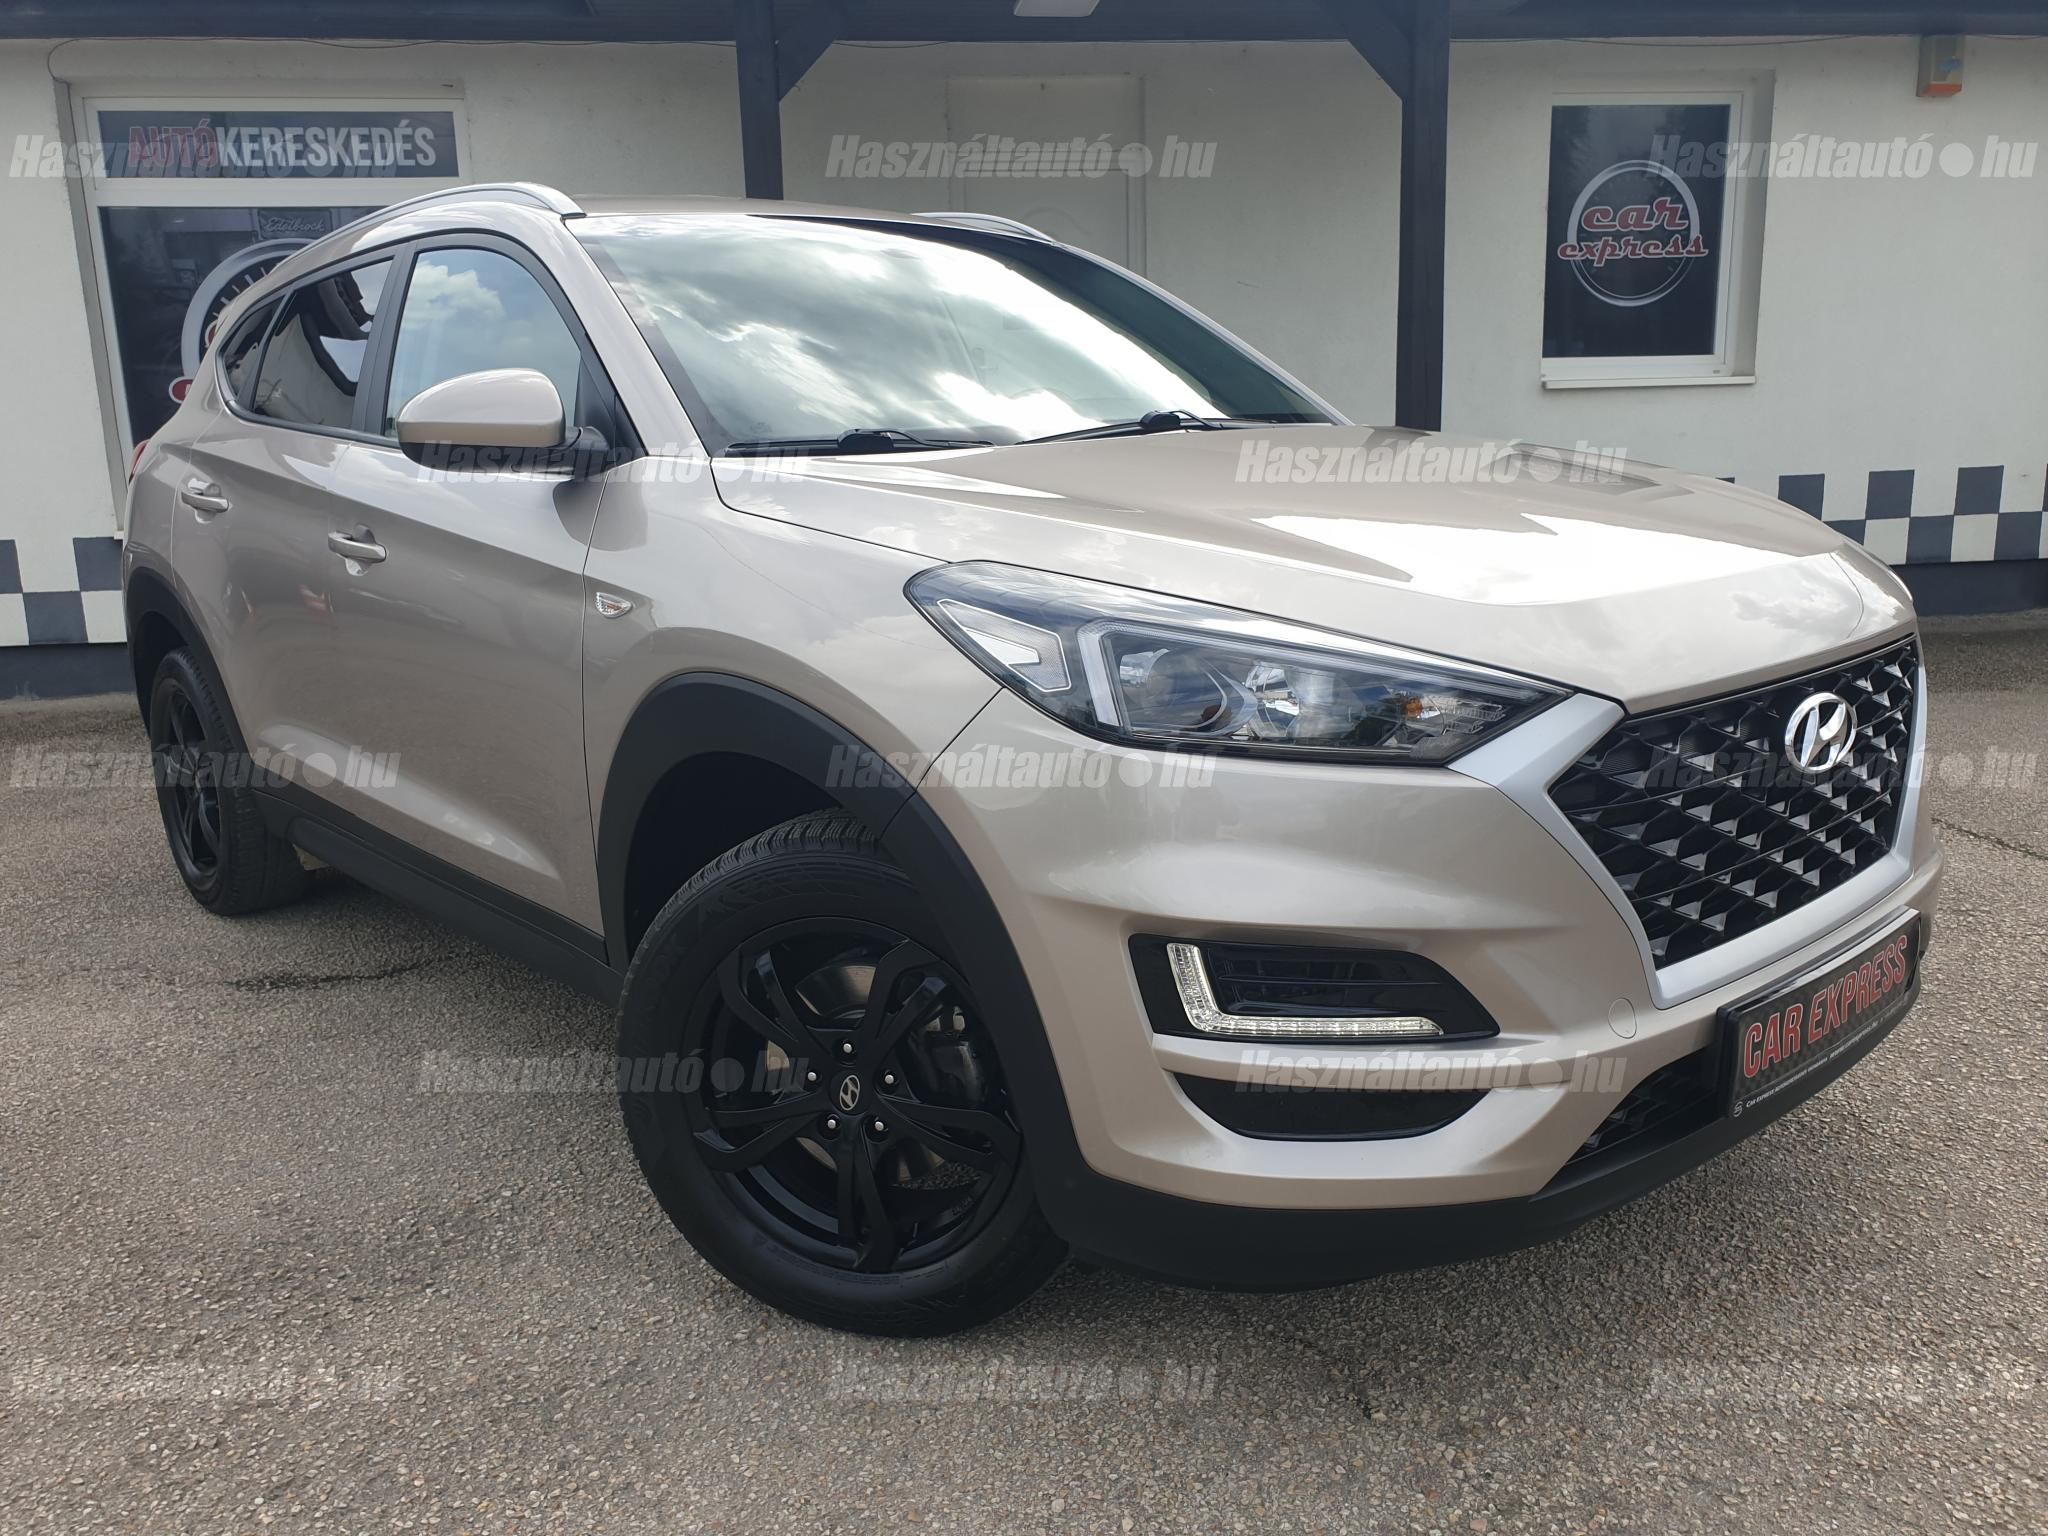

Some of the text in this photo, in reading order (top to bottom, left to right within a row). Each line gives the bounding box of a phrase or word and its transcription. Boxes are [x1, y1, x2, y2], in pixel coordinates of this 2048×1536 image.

[1581, 197, 1689, 232] car
[1558, 234, 1709, 267] express
[1743, 1003, 1803, 1078] CAR
[1808, 935, 1908, 1044] EXPRESS
